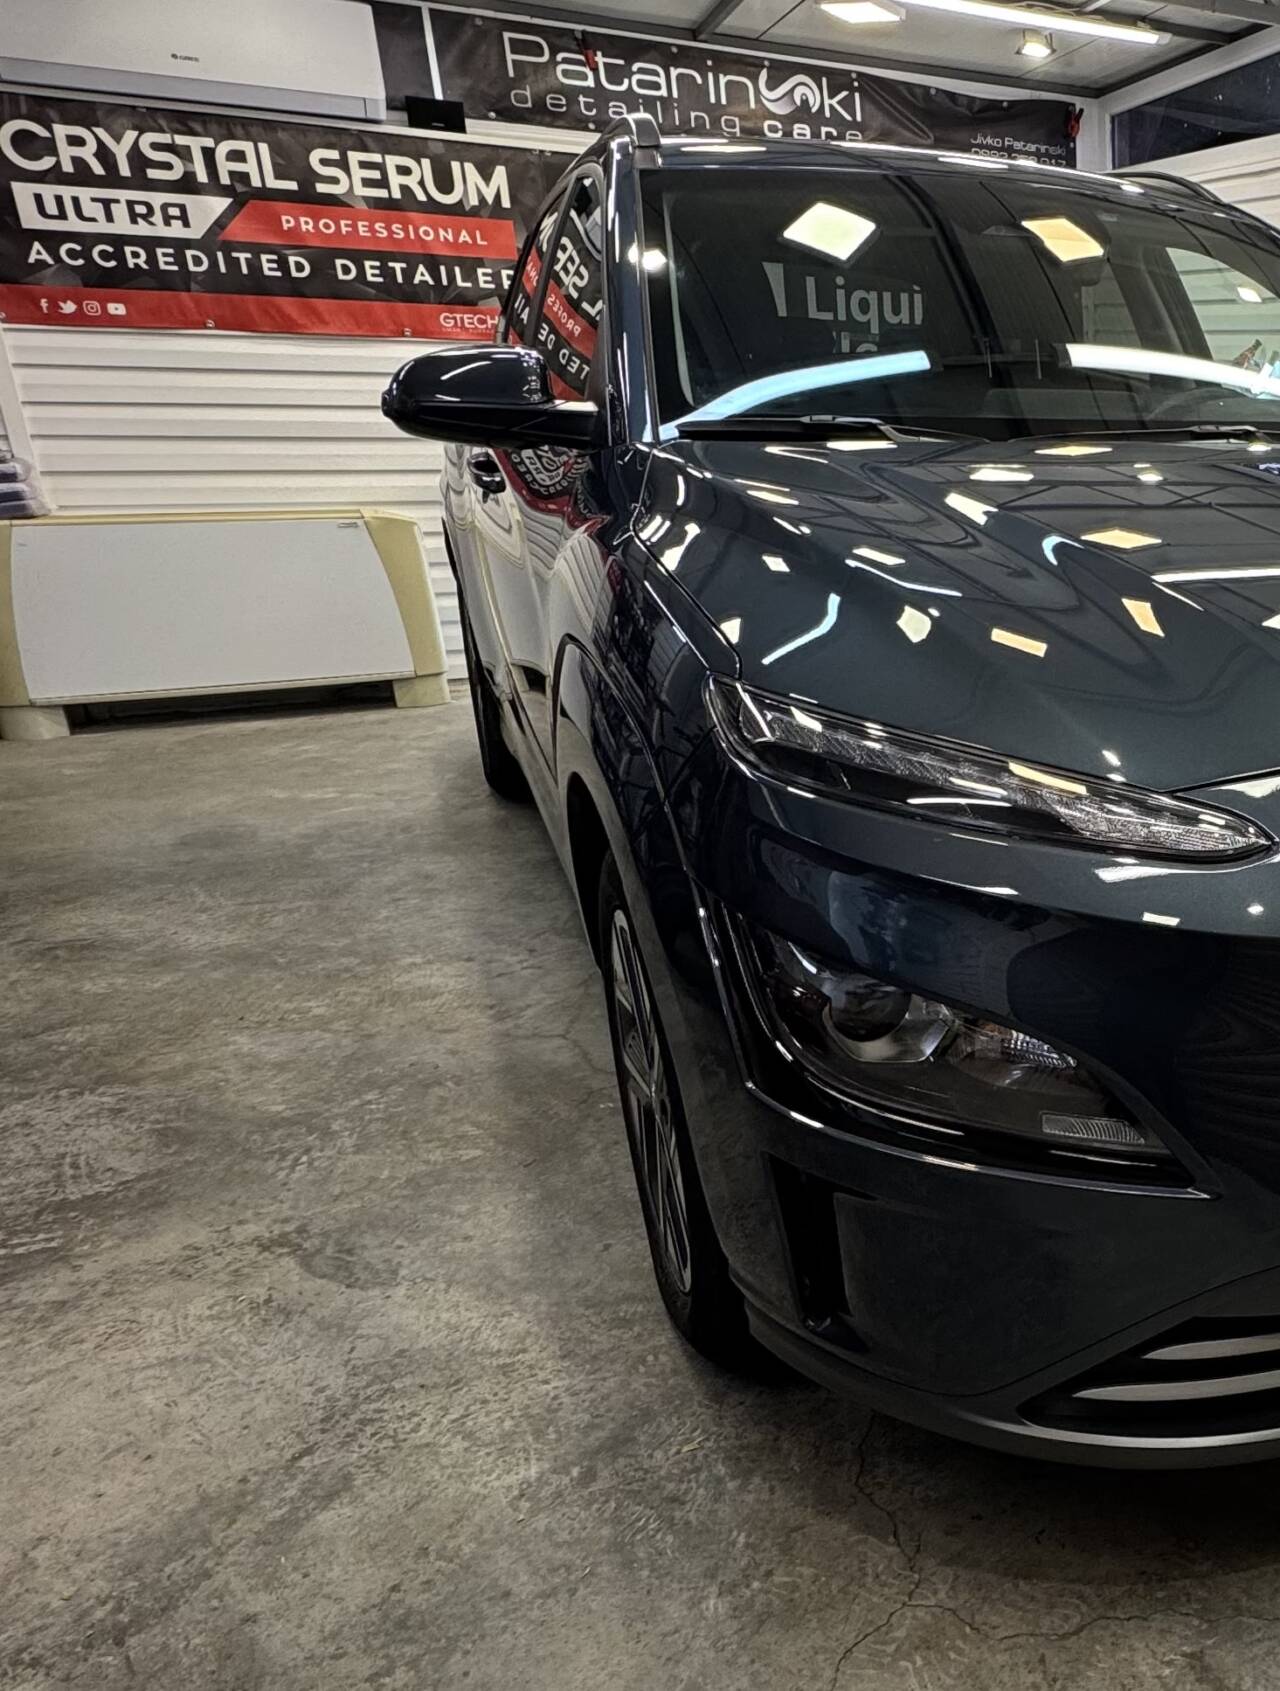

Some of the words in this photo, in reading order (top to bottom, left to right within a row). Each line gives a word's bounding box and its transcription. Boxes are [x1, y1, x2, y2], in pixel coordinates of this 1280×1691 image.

[763, 120, 862, 141] care
[0, 119, 298, 191] CRYSTAL
[309, 148, 511, 209] SERUM
[32, 192, 192, 229] ULTRA
[280, 215, 488, 246] PROFESSIONAL
[28, 241, 311, 278] ACCREDITED
